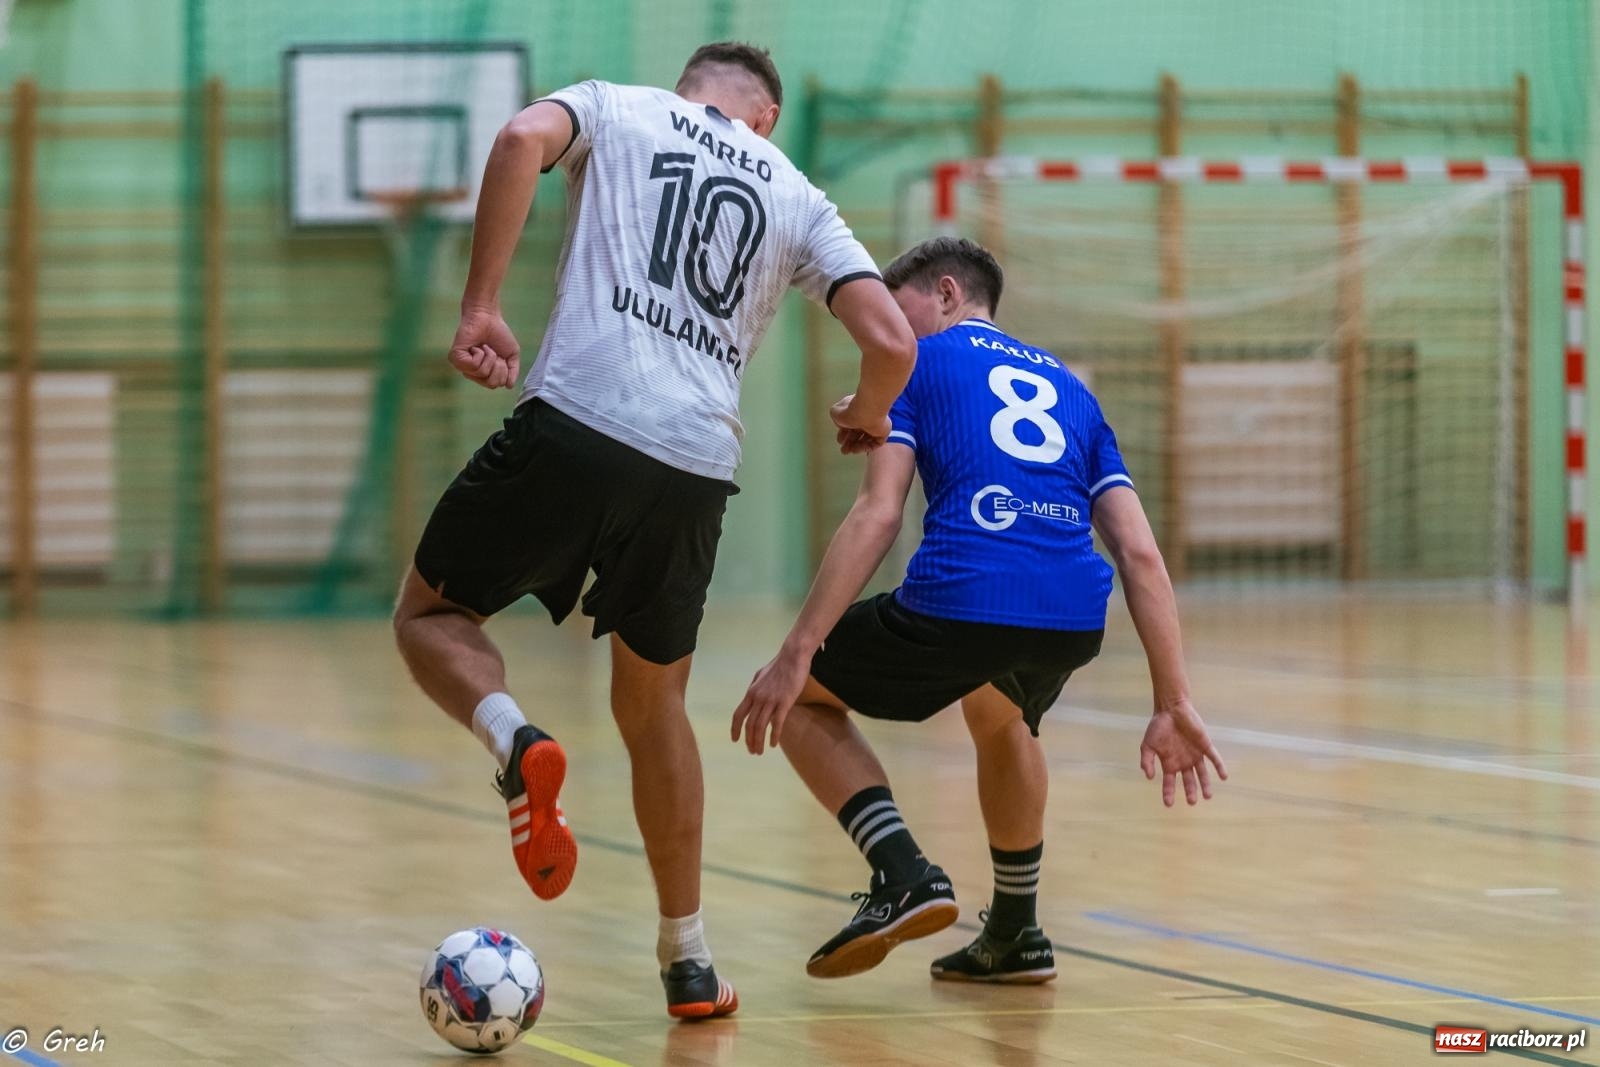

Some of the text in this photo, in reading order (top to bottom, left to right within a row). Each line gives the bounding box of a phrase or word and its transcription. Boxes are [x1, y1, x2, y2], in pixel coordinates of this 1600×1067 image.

[671, 111, 772, 183] WARŁO
[648, 152, 766, 320] 10
[969, 336, 1059, 369] KAŁUS
[988, 364, 1067, 464] 8
